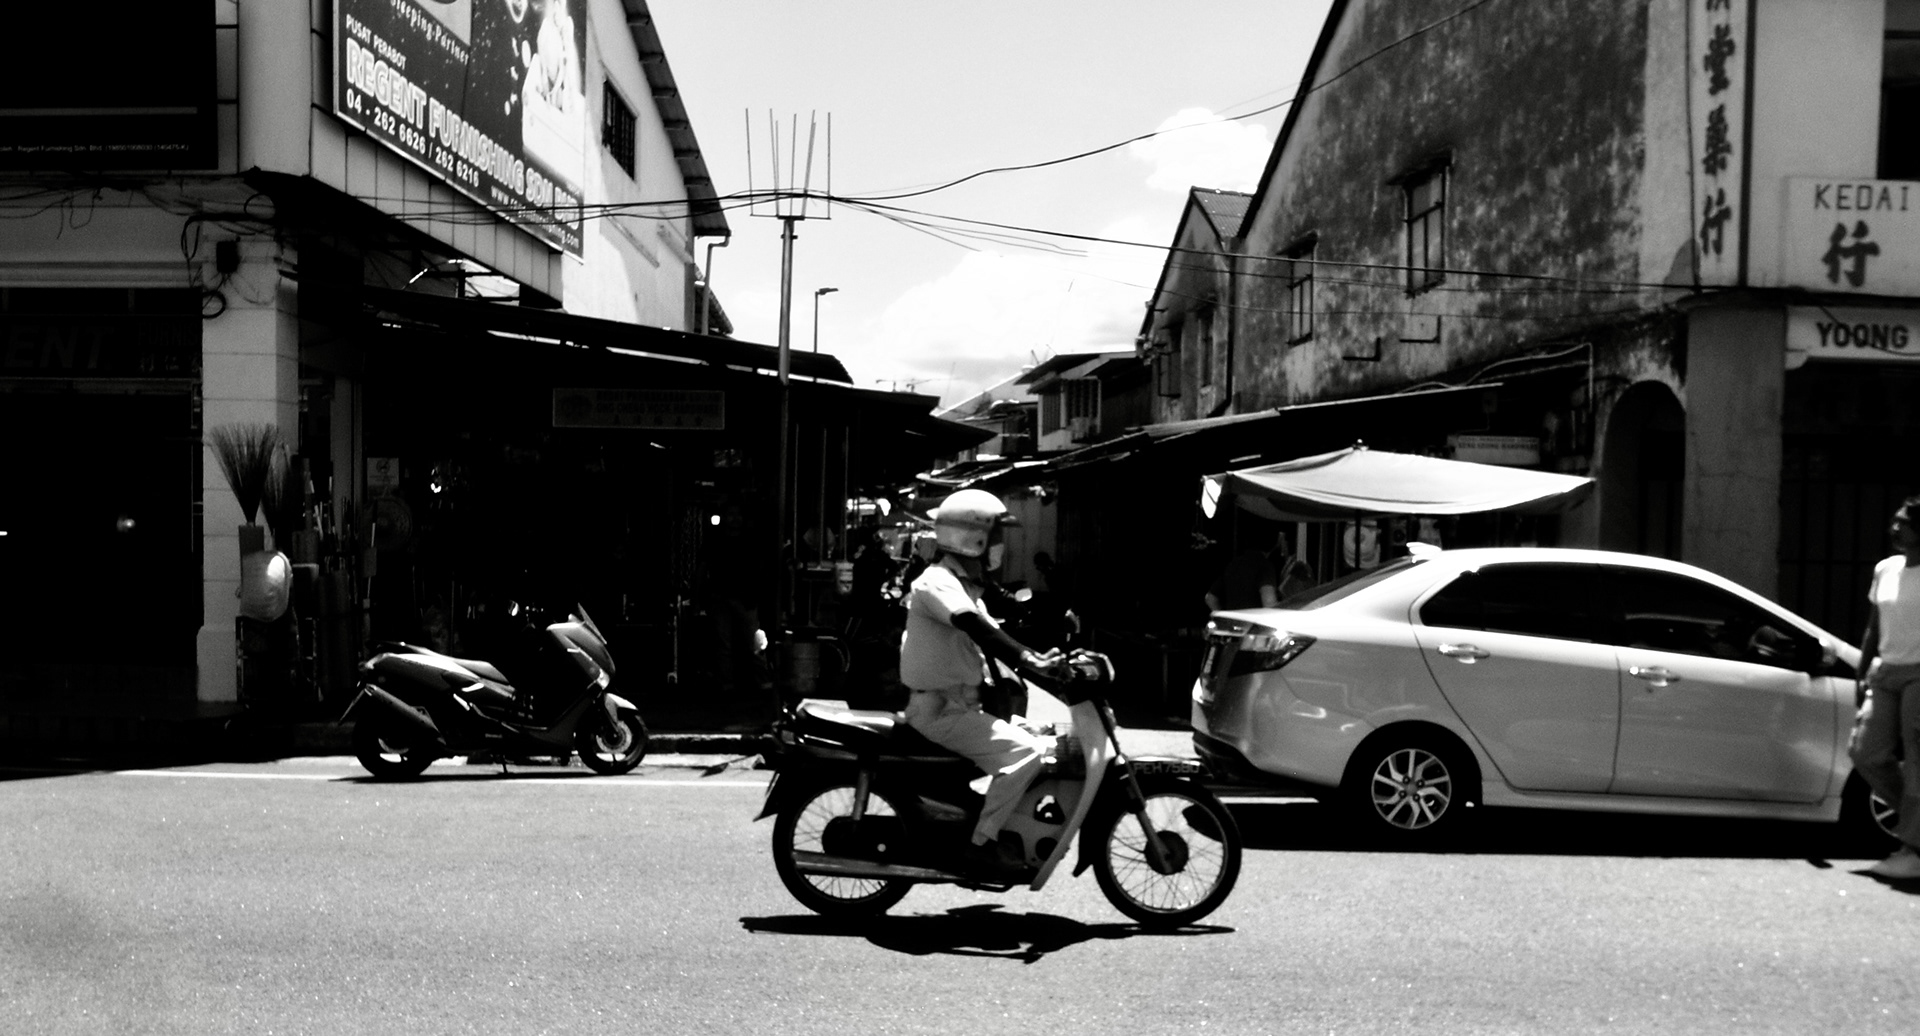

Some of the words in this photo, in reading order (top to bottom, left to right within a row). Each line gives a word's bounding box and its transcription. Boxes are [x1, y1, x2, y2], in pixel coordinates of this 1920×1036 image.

[346, 13, 371, 44] PUSAT
[373, 34, 407, 70] PERABOT
[346, 37, 428, 131] REGENT
[428, 96, 525, 196] FURNISHING
[525, 166, 554, 208] SDN
[346, 88, 363, 114] 04
[373, 106, 397, 136] 262
[398, 123, 426, 155] 6626
[435, 146, 454, 172] 262
[456, 160, 480, 188] 6216
[1814, 184, 1910, 211] KEDAI
[1821, 219, 1881, 288] 行
[1816, 321, 1909, 349] YOONG
